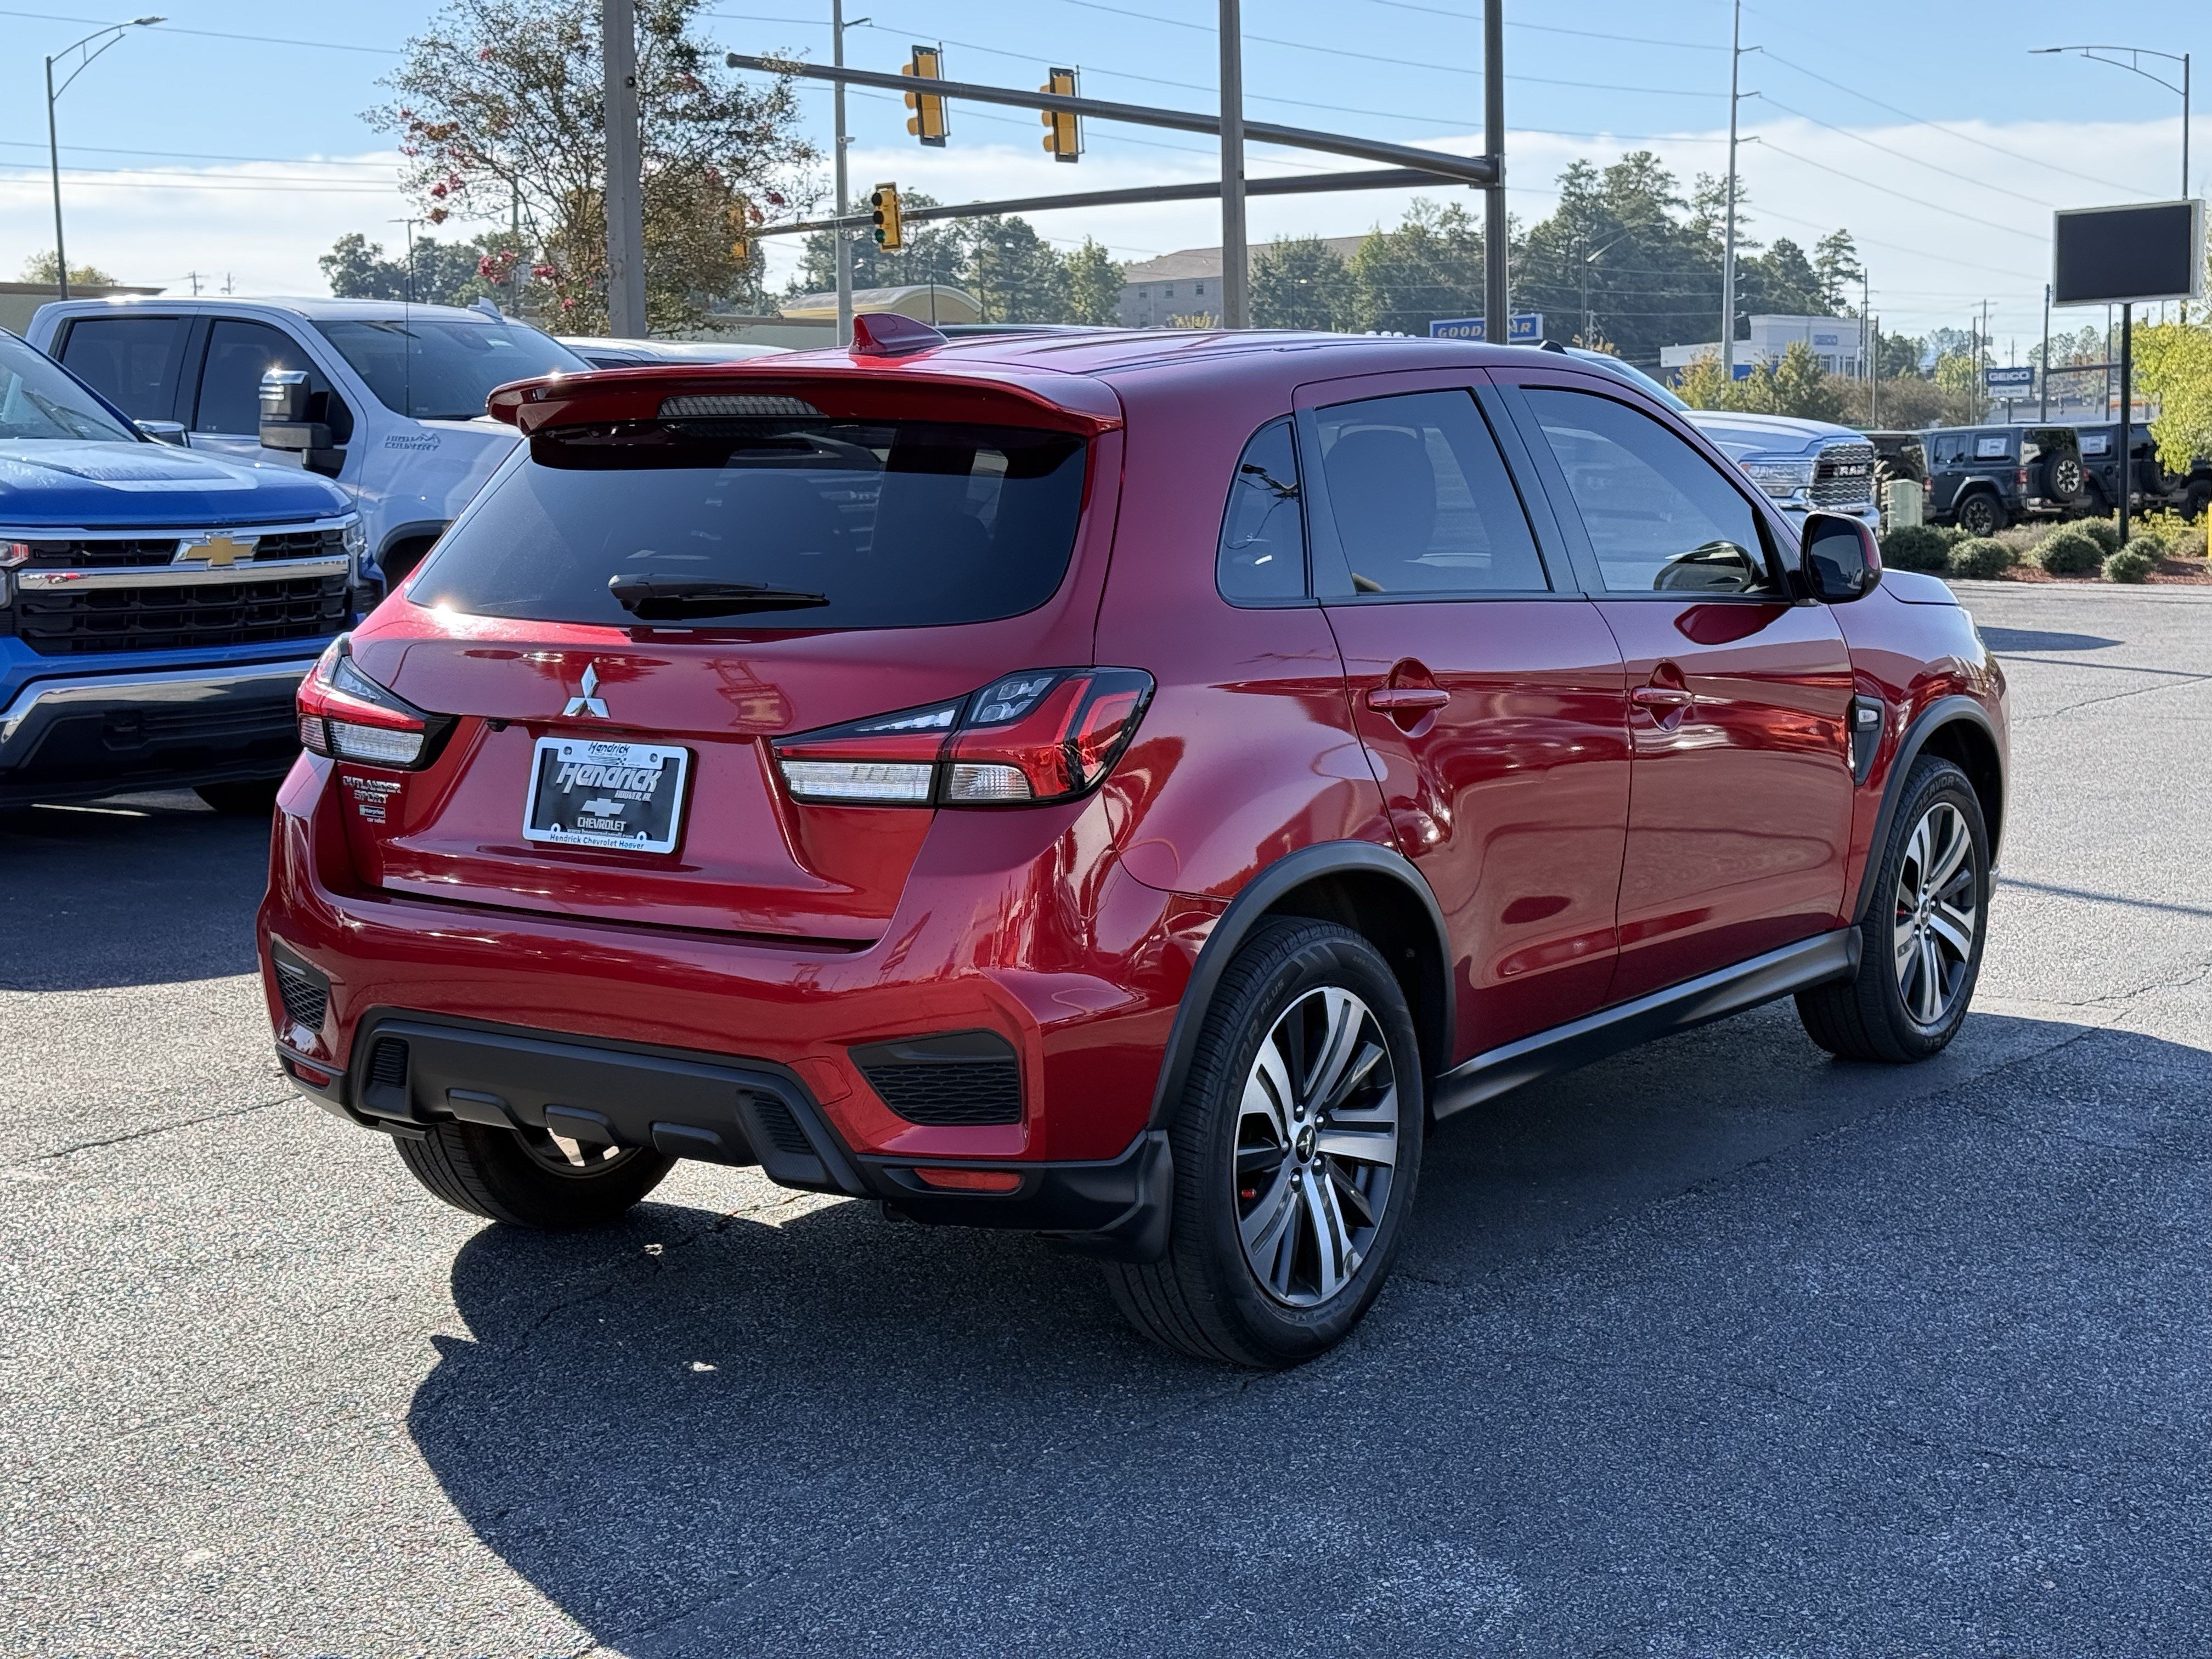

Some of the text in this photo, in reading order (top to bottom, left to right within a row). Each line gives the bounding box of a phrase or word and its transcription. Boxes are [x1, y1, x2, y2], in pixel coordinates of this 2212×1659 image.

[1437, 322, 1532, 338] GOODAR
[1988, 371, 2030, 381] GEICO
[1839, 465, 1866, 476] RAM
[342, 775, 402, 794] OUTLANDER
[556, 763, 663, 794] Hendrick
[353, 789, 389, 804] SPORT
[577, 816, 627, 832] CHEVROLET
[550, 833, 645, 850] Hendrick Chevrolet Hoover
[1260, 978, 1284, 1015] PLUS
